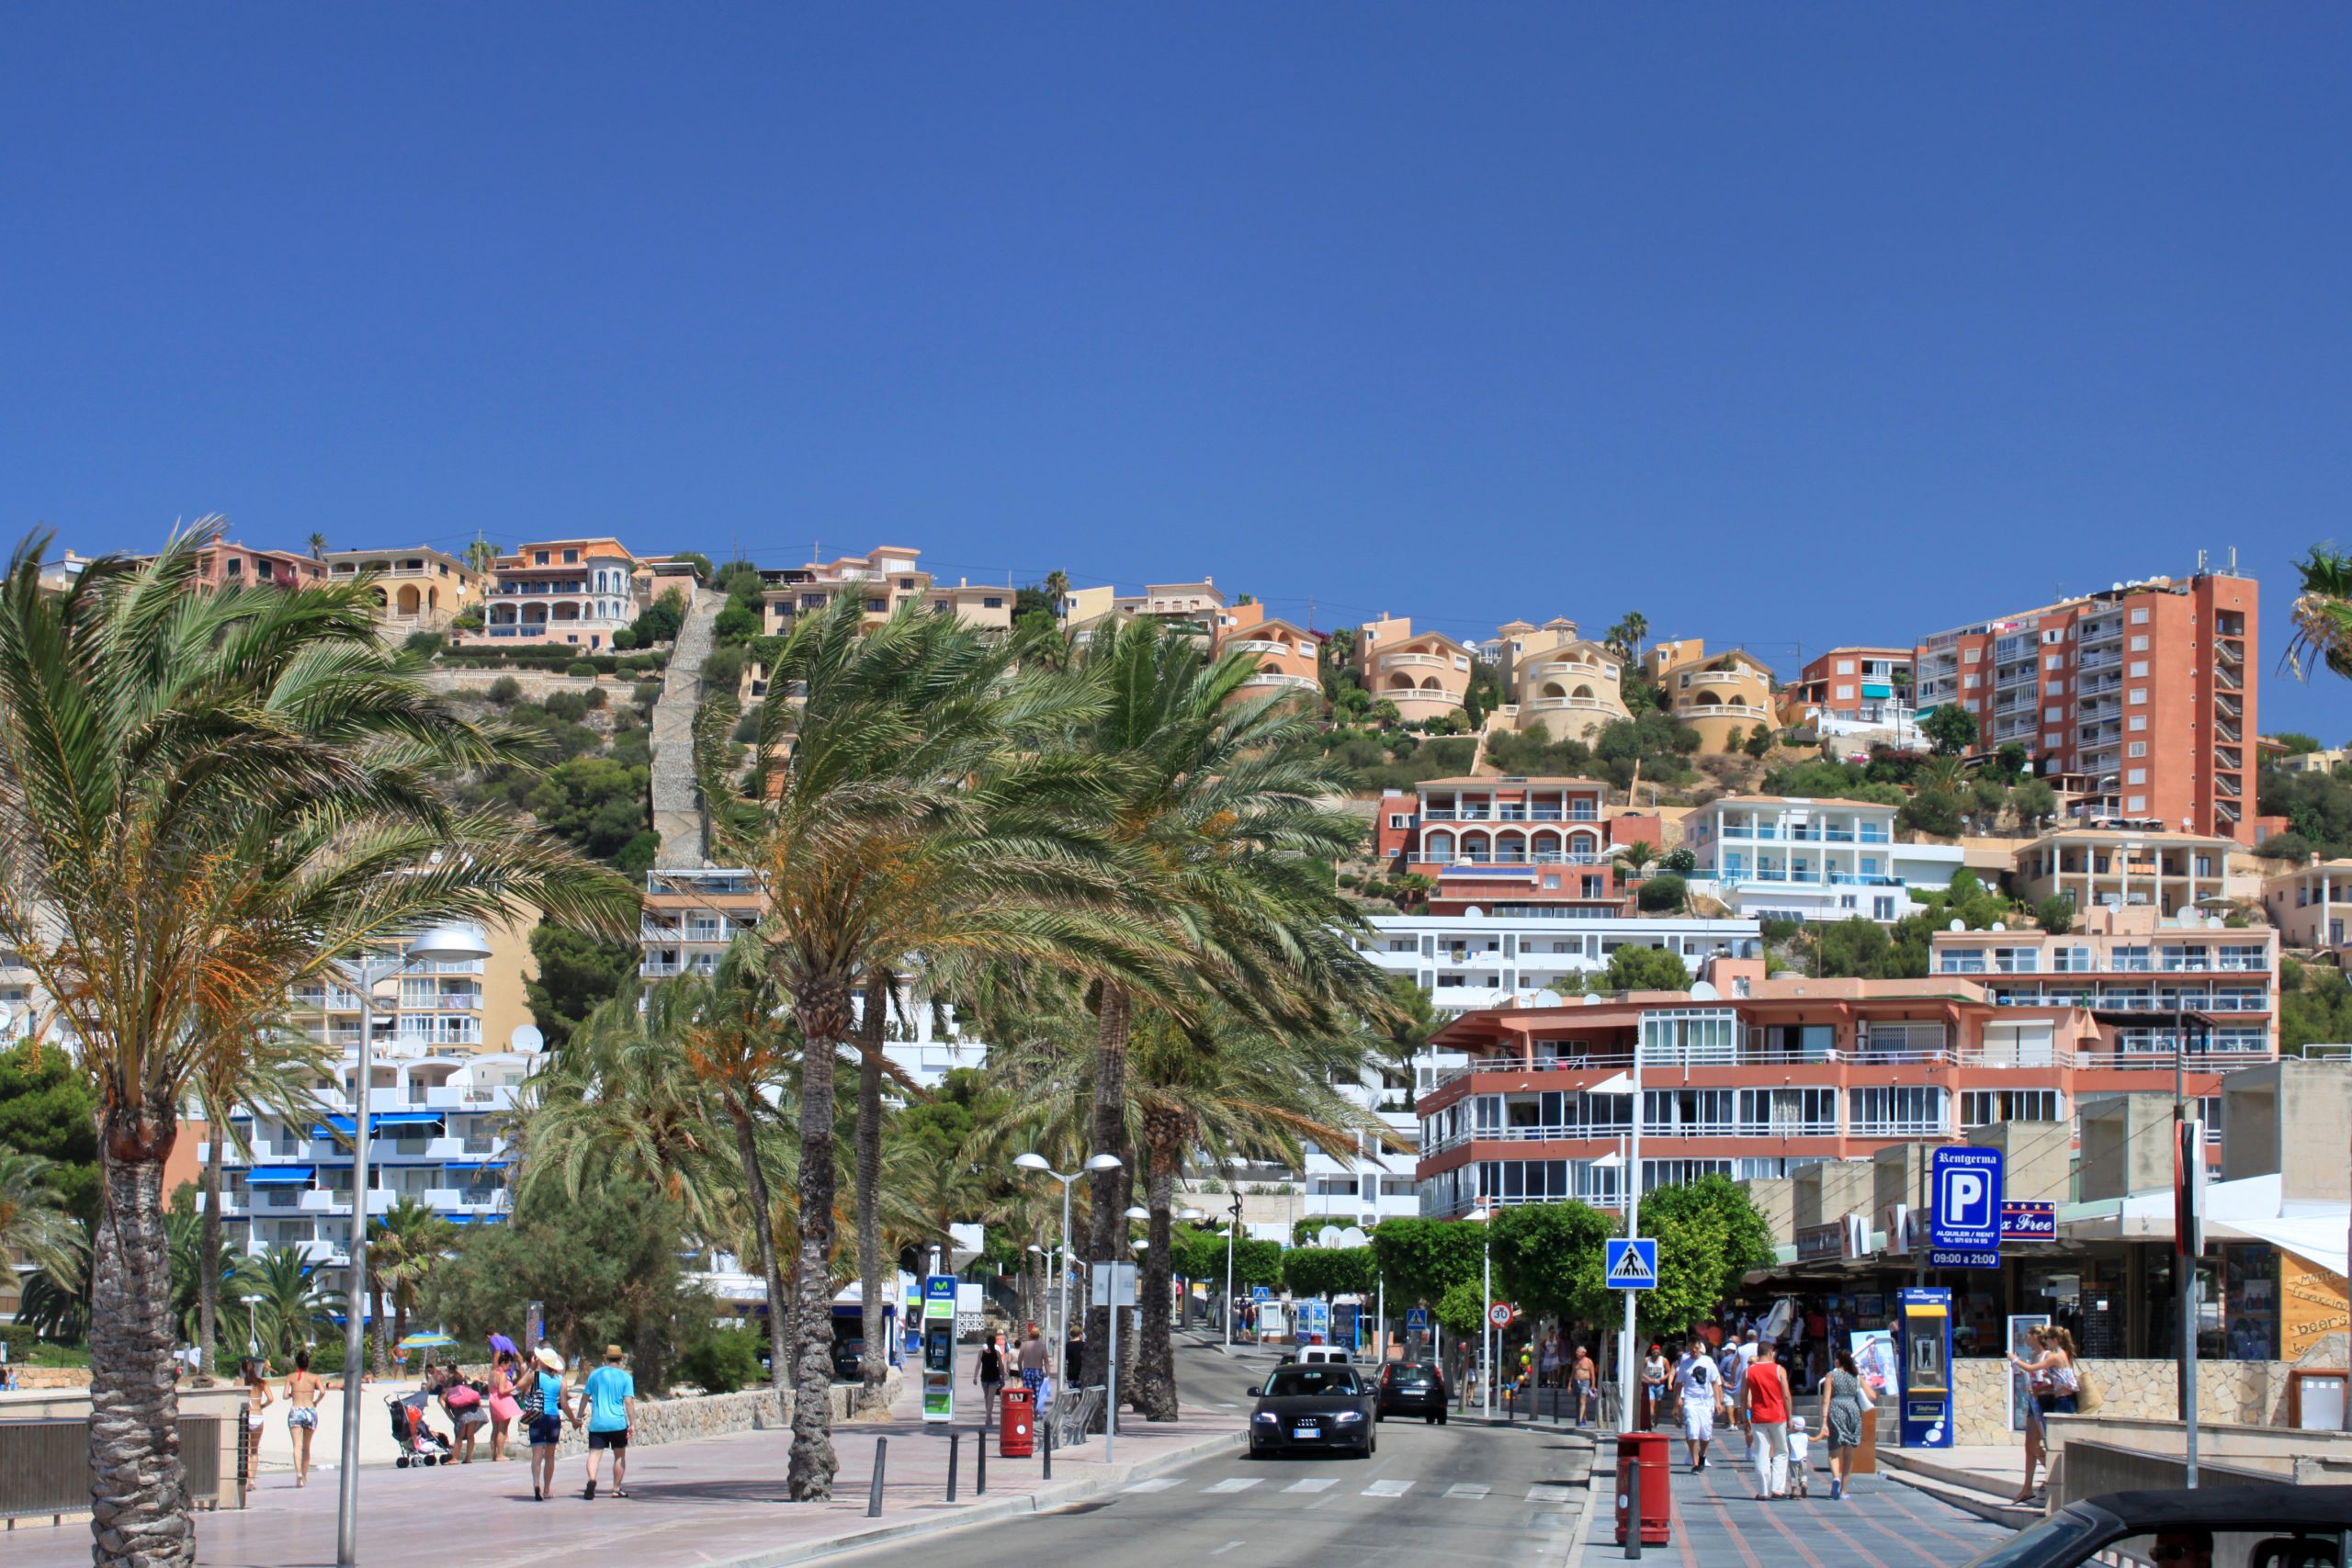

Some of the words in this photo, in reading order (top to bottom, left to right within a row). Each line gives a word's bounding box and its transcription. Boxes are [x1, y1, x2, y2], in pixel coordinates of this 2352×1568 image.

[1939, 1152, 1996, 1165] Rentgerma
[1951, 1174, 1982, 1222] P
[2016, 1213, 2052, 1231] Free
[1933, 1253, 1962, 1264] 09:00
[1963, 1256, 1969, 1264] a
[1971, 1254, 1996, 1264] 21:00
[1494, 1311, 1508, 1319] 30
[2297, 1314, 2347, 1336] beers
